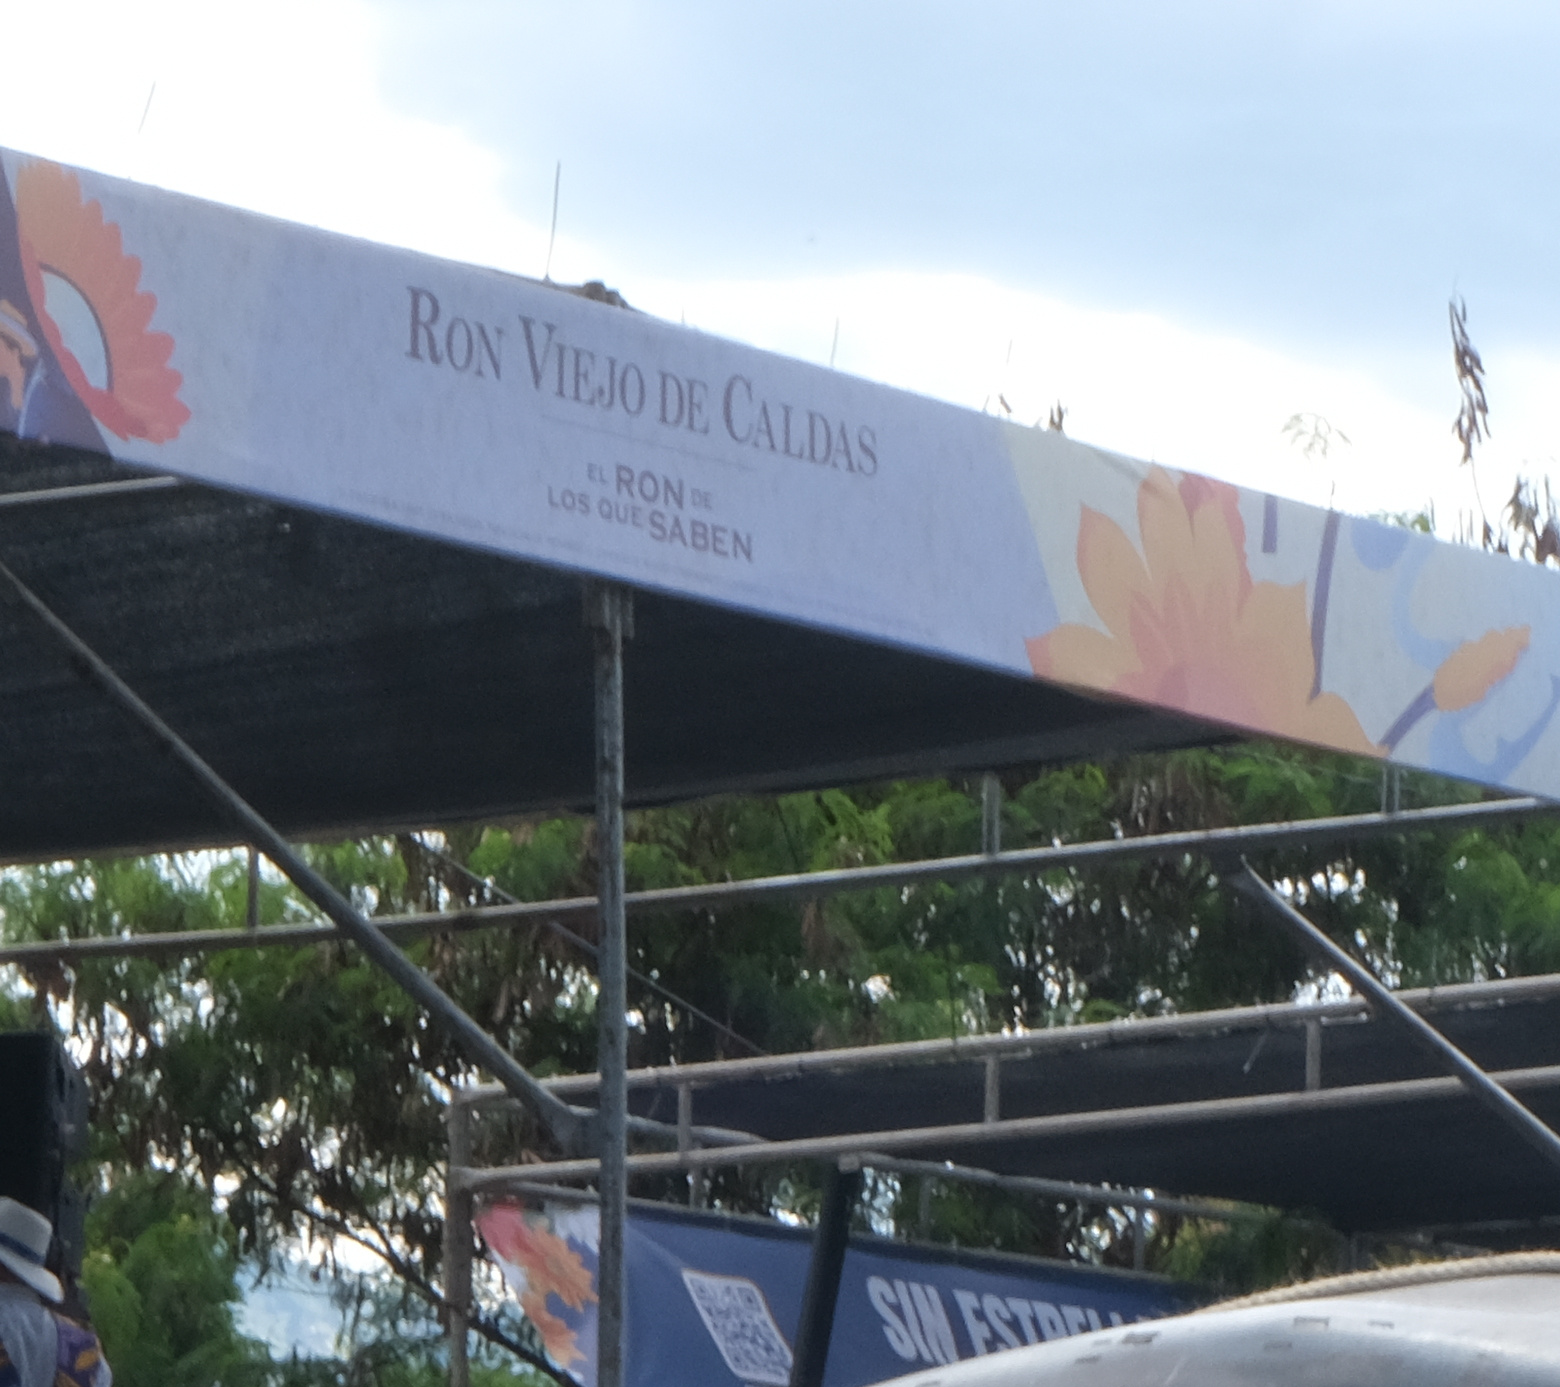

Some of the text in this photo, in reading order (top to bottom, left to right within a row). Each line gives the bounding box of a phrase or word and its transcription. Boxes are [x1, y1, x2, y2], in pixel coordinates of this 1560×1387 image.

[404, 284, 881, 479] RON VIEJO DE CALDAS
[547, 484, 592, 517] LOS
[597, 494, 645, 529] QUE
[648, 508, 756, 565] SABEN
[586, 462, 714, 513] EL RON DE
[866, 1275, 959, 1366] SIN
